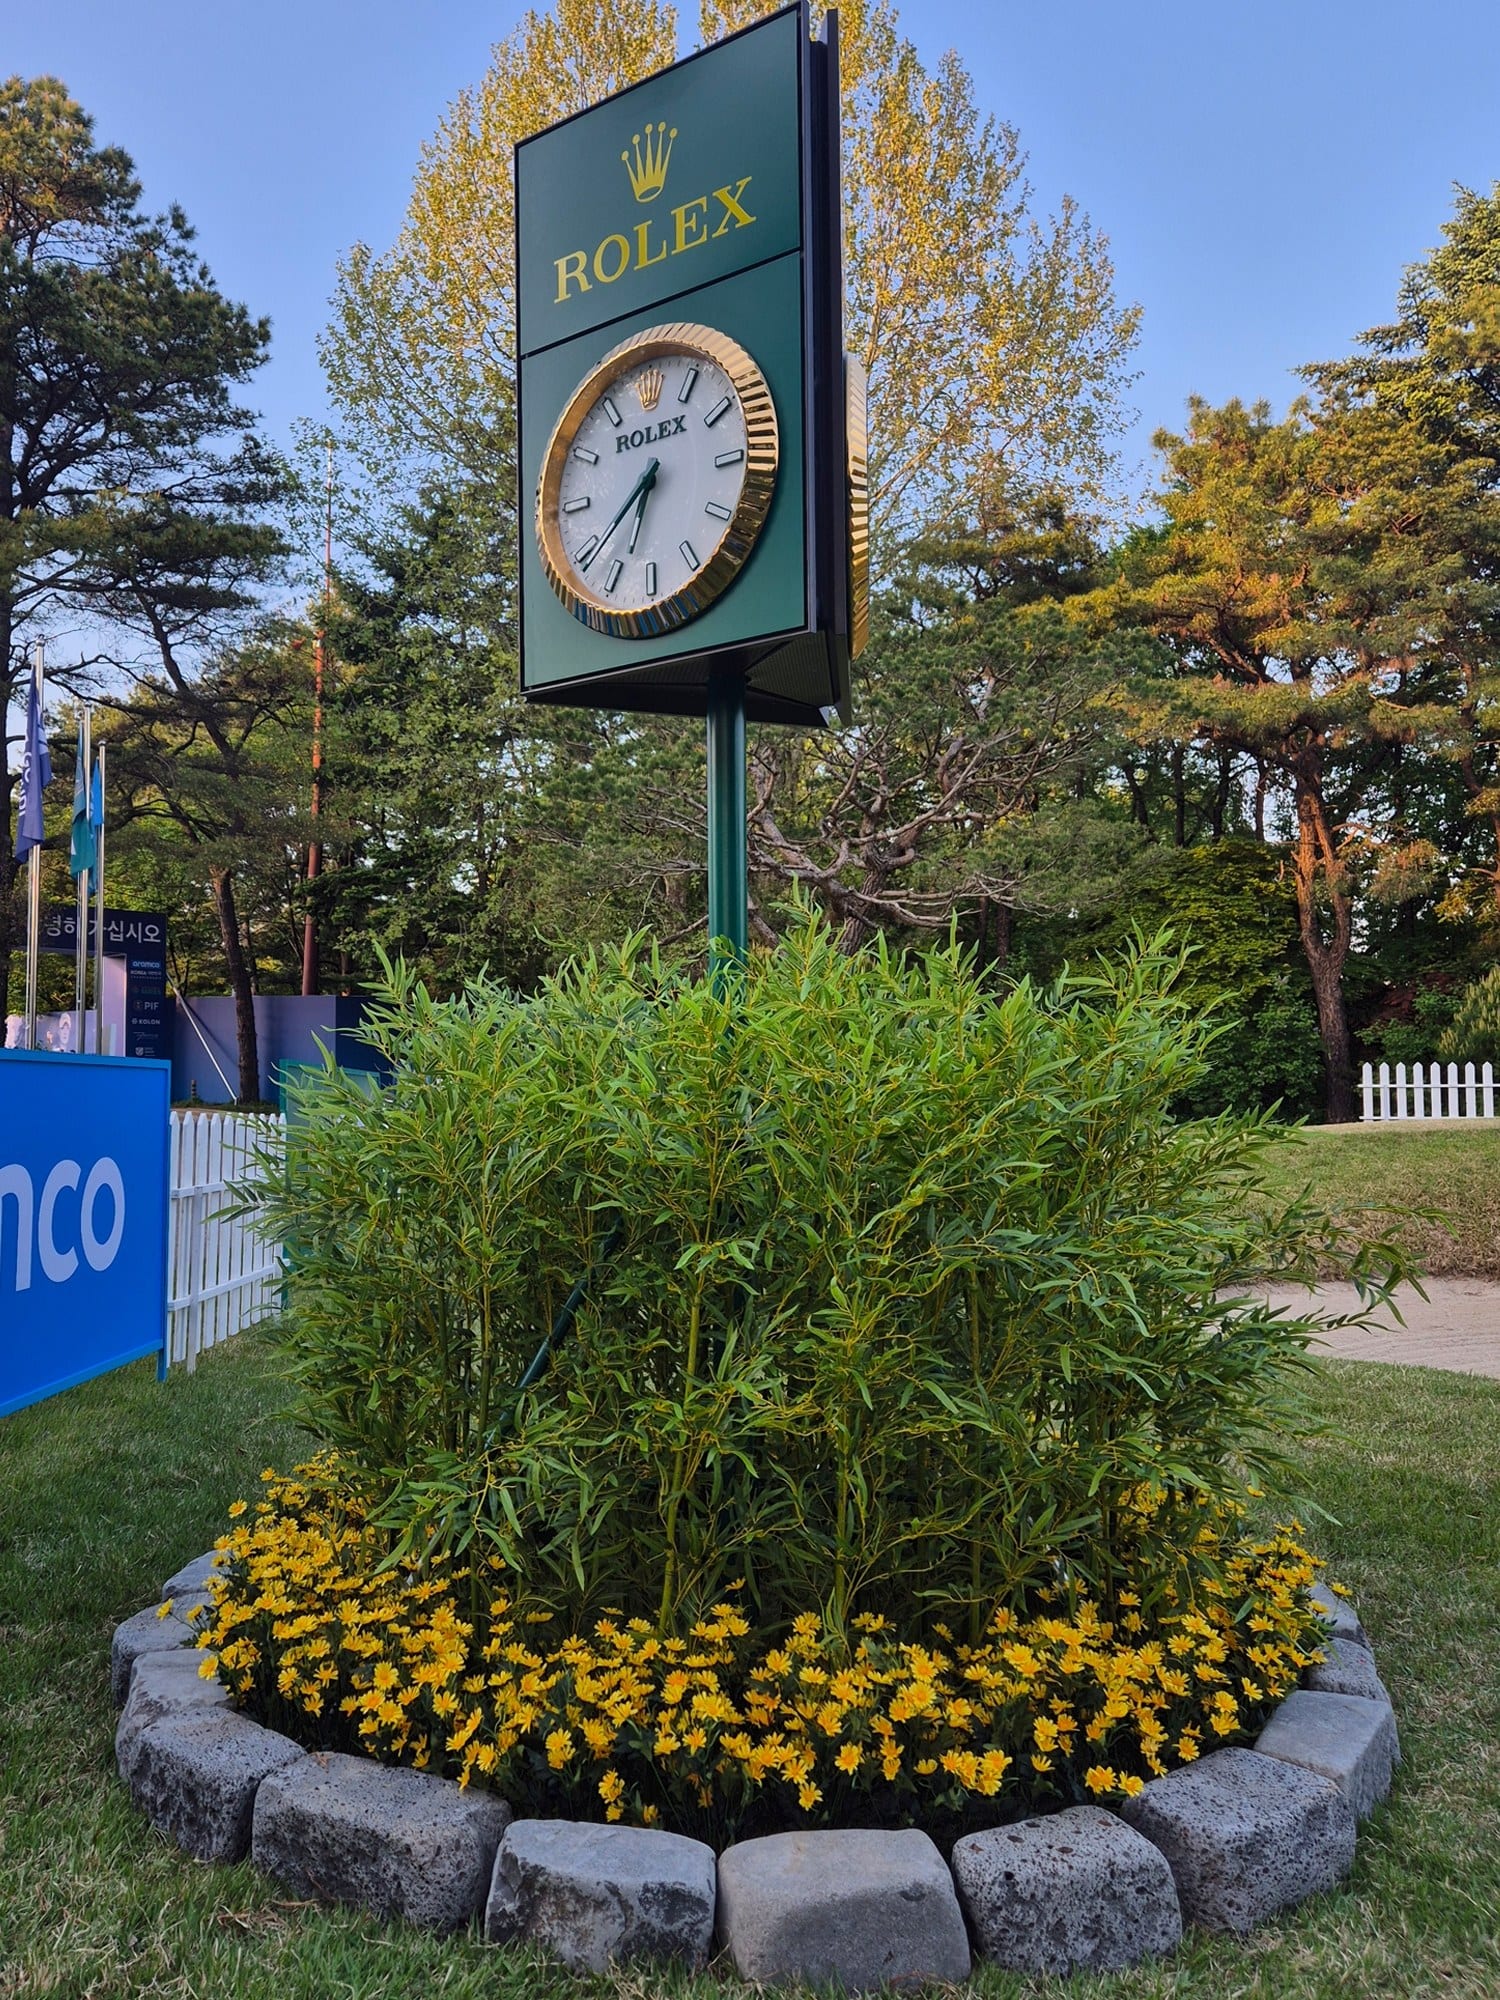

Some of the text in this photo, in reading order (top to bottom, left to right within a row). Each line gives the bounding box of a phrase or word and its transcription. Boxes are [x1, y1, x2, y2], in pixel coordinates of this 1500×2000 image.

[553, 175, 757, 304] ROLEX
[615, 414, 687, 454] ROLEX
[132, 961, 160, 969] aramco
[144, 1001, 160, 1010] PIF
